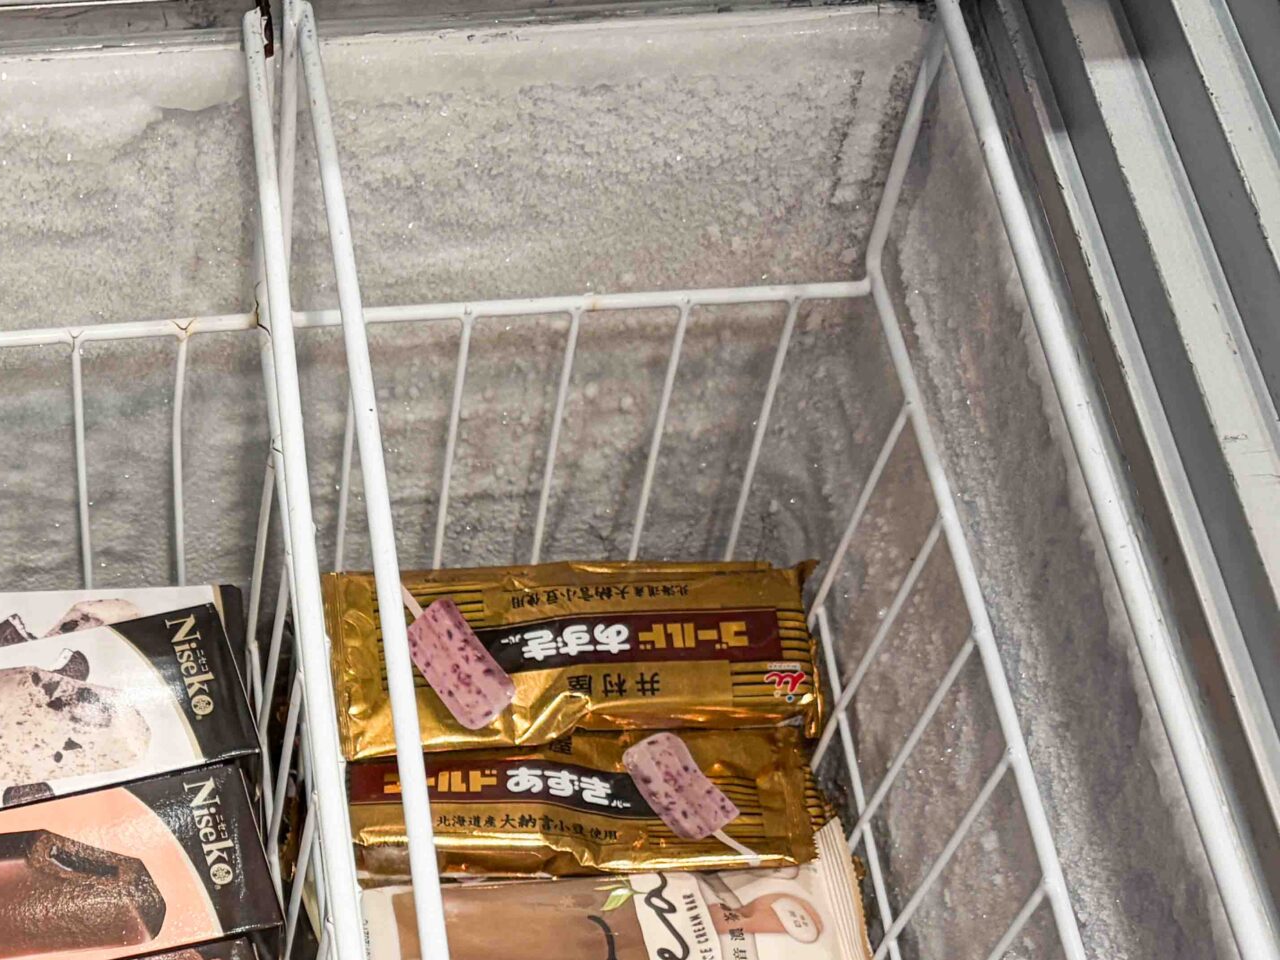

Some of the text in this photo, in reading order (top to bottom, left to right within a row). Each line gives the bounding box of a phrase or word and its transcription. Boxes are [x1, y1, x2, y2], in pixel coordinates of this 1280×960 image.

[165, 613, 215, 720] Niseko
[567, 671, 661, 697] 井村屋
[183, 775, 234, 886] Niseko
[682, 893, 710, 945] CREAM BAR
